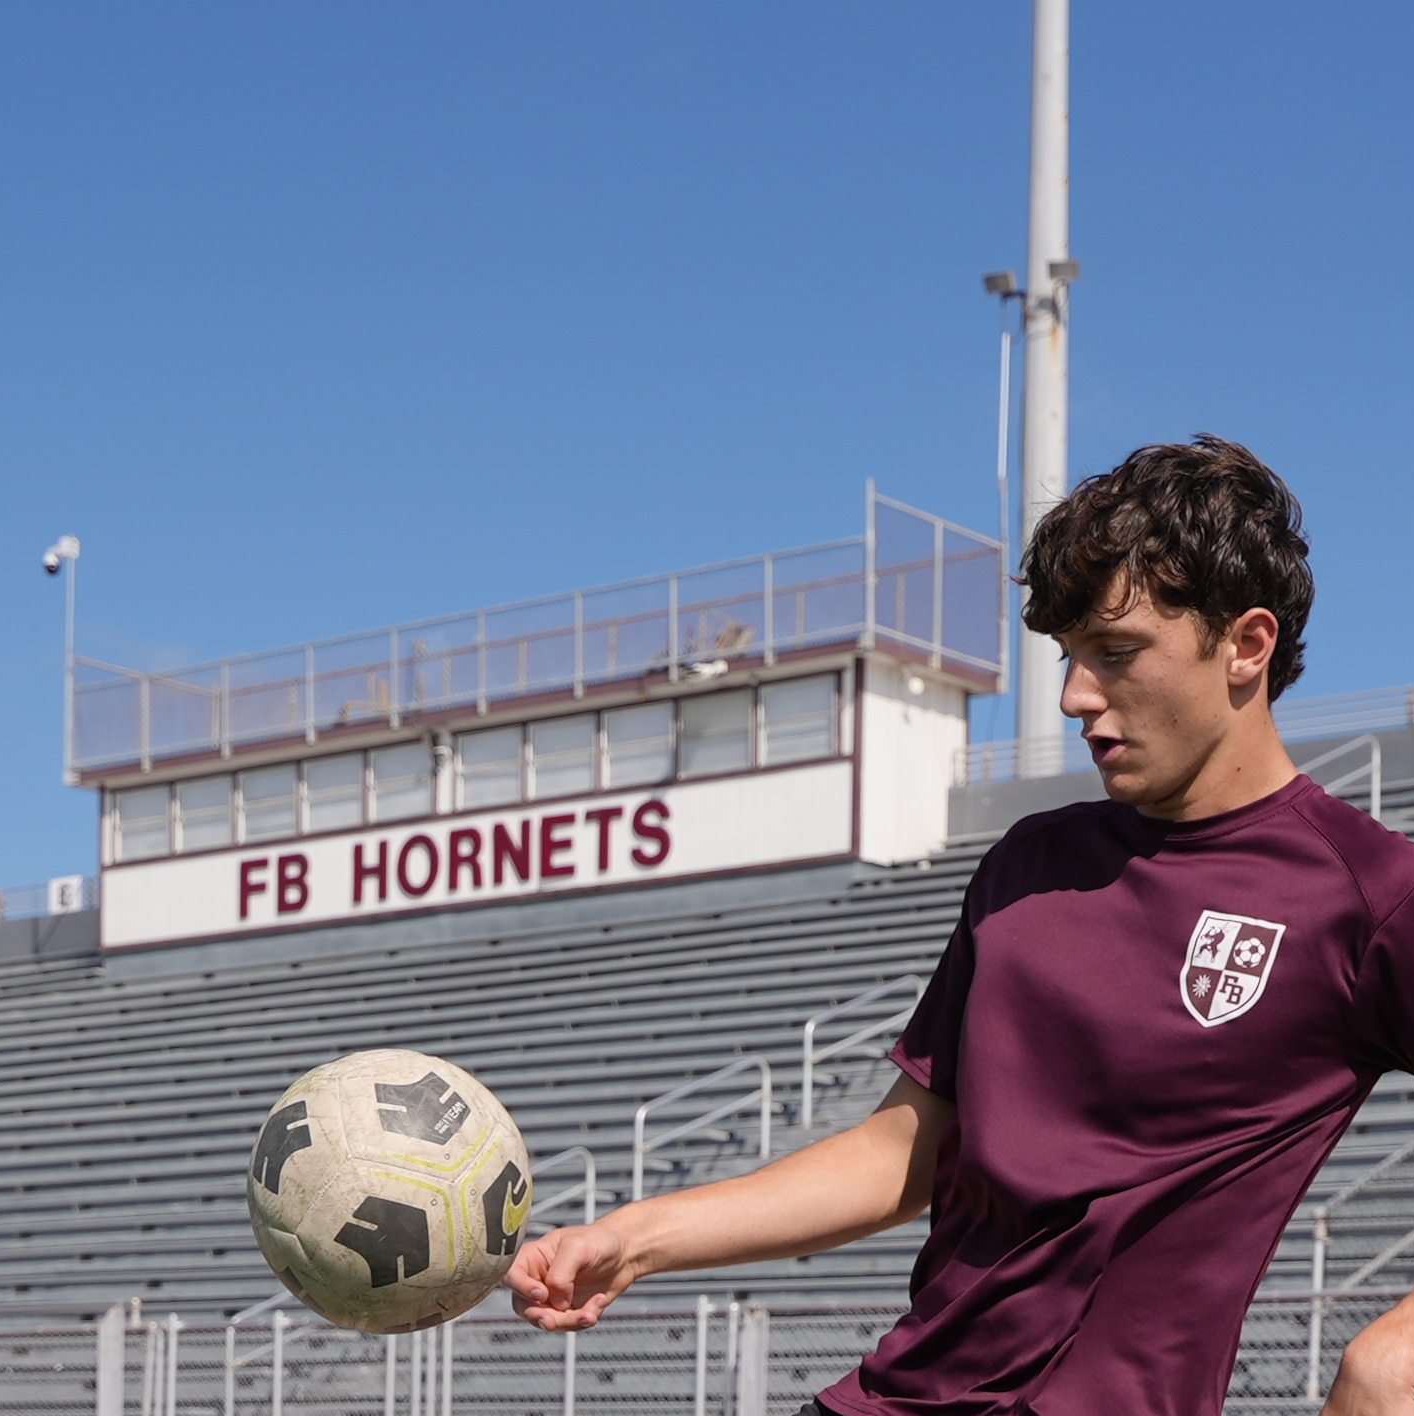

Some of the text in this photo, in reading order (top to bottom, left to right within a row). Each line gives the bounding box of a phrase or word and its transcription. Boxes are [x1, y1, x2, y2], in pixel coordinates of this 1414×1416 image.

[239, 800, 672, 919] FB HORNETS
[1219, 974, 1244, 1005] FB
